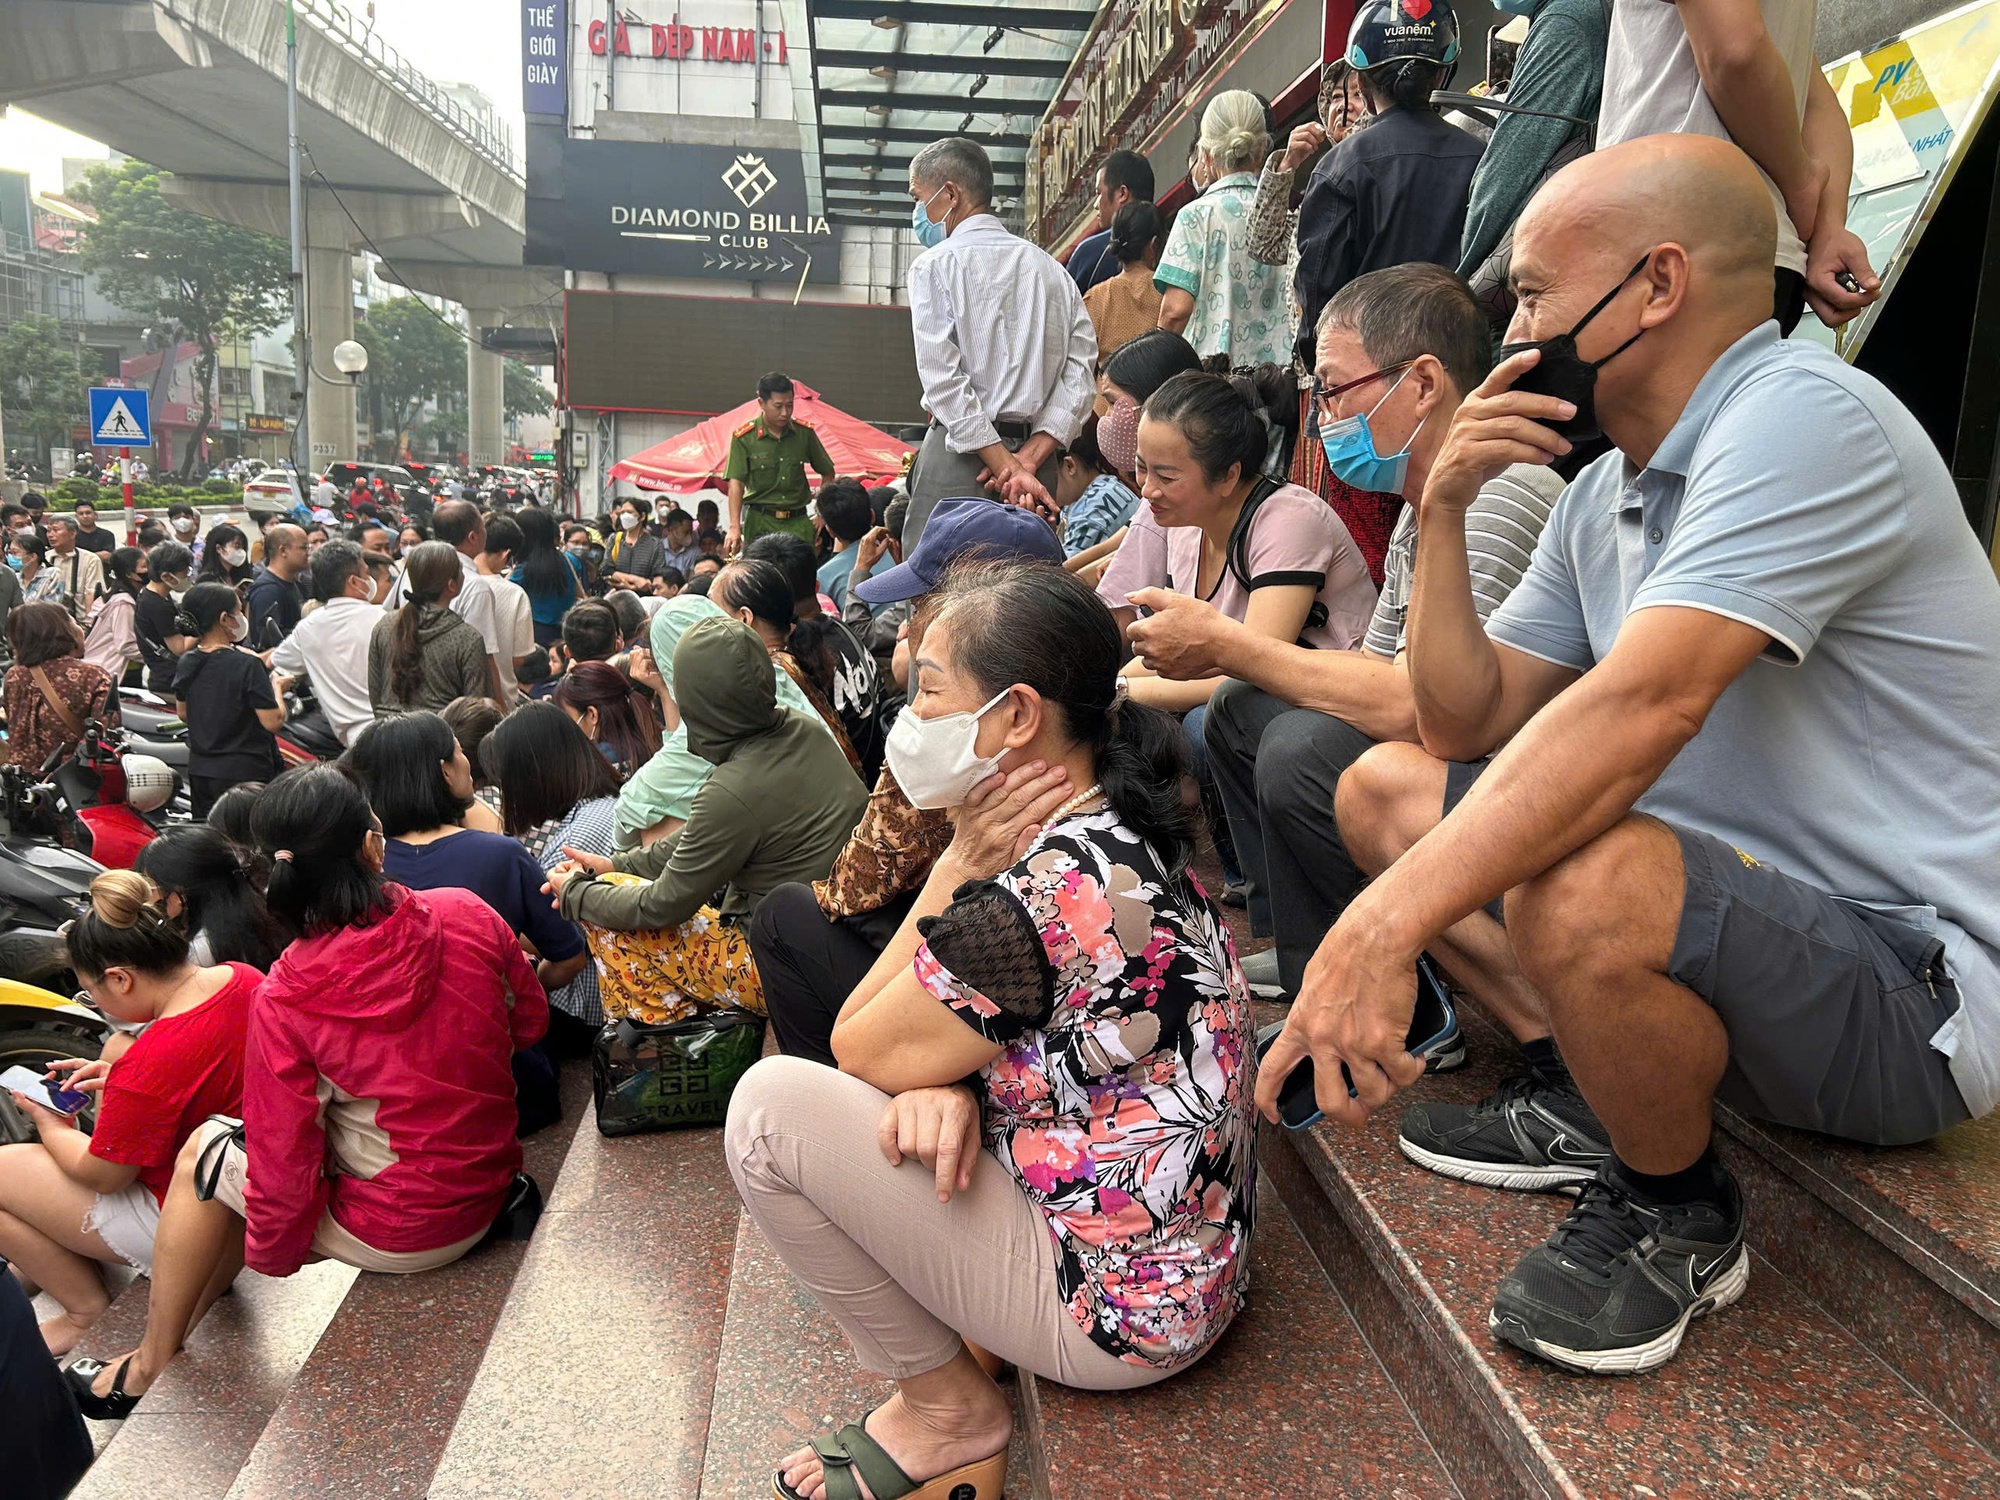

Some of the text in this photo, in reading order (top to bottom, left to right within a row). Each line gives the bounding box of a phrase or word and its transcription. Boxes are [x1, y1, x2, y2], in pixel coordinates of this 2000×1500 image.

[528, 4, 556, 28] THẾ
[530, 34, 556, 56] GIỚI
[703, 26, 755, 62] NAM
[528, 62, 558, 84] GIÀY
[1103, 0, 1174, 136] MINH
[1185, 46, 1199, 85] KIM
[1912, 124, 1954, 153] NHẤT
[611, 206, 741, 230] DIAMOND
[719, 234, 769, 249] CLUB
[313, 444, 336, 455] P337
[643, 1100, 725, 1119] TRAVEL
